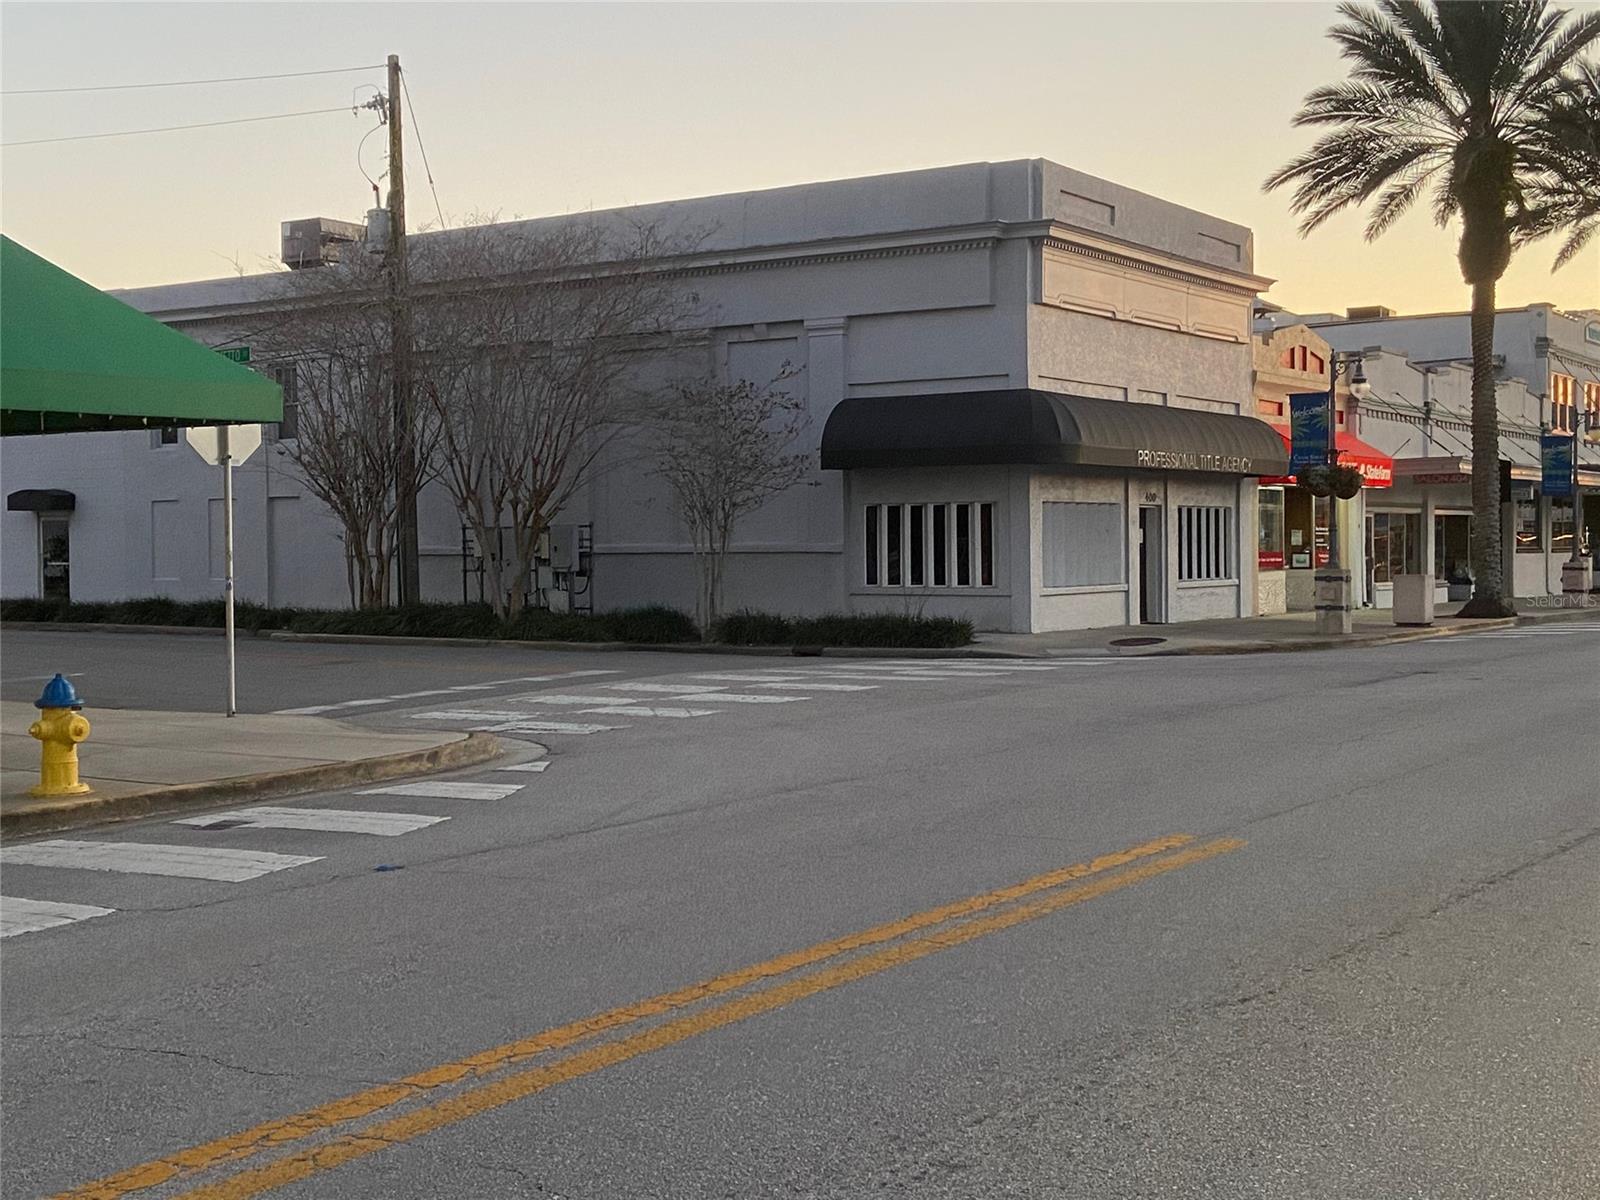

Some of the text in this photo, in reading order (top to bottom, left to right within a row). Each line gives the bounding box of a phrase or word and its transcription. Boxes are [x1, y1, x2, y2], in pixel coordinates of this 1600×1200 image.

[1137, 450, 1252, 473] PROFESSIONAL TITLE AGENCY
